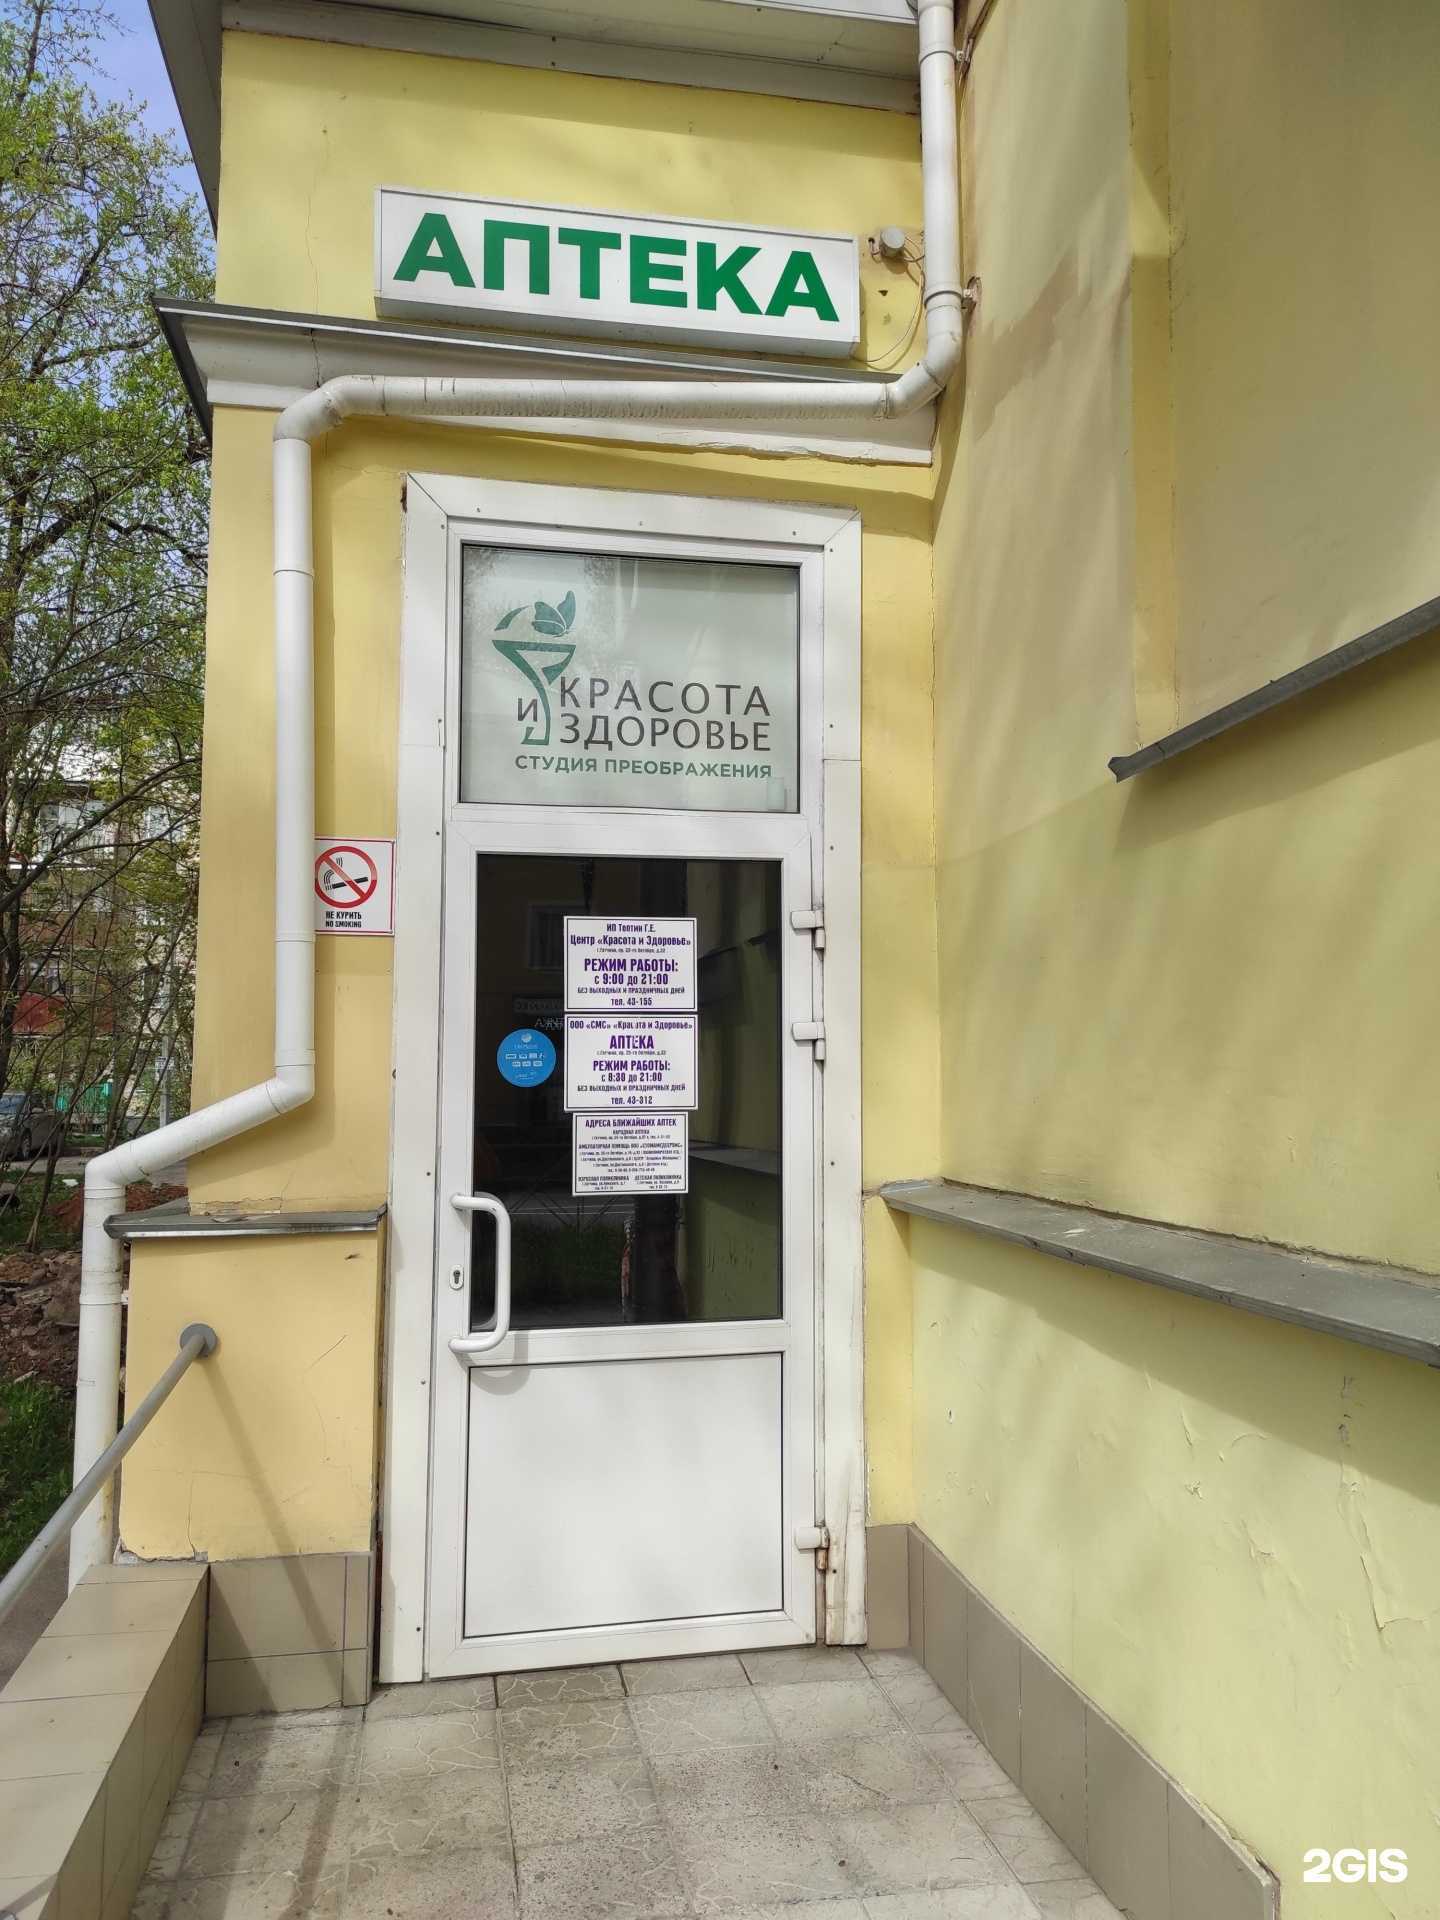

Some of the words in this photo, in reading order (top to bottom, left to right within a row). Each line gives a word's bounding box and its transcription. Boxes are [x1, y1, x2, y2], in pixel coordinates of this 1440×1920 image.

[393, 212, 840, 322] АПТЕКА
[560, 676, 770, 716] КРАСОТА
[560, 713, 771, 751] ЗДОРОВЬЕ
[515, 755, 597, 773] СТУДИЯ
[605, 759, 772, 778] ПРЕОБРАЖЕНИЯ
[325, 911, 334, 919] НЕ
[336, 911, 362, 920] КУРИТЬ
[607, 923, 616, 932] ИП
[570, 934, 595, 946] Центр
[598, 934, 636, 946] «Красота
[646, 935, 690, 946] Здоровье»
[584, 958, 626, 972] РЕЖИМ
[630, 958, 679, 972] РАБОТЫ:
[594, 976, 599, 984] с
[603, 973, 624, 984] 9:00
[627, 976, 638, 986] до
[641, 973, 669, 985] 21:00
[611, 998, 625, 1006] тел.
[627, 997, 653, 1006] 43-155
[570, 1020, 584, 1029] ООО
[586, 1020, 611, 1030] «СМС»
[654, 1020, 693, 1030] Здоровье»
[610, 1035, 654, 1049] АПТЕКА
[593, 1060, 628, 1071] РЕЖИМ
[630, 1060, 671, 1071] РАБОТЫ:
[601, 1074, 606, 1082] с
[628, 1074, 638, 1083] до
[640, 1072, 662, 1082] 21:00
[628, 1084, 669, 1092] ПРАЗДНИЧНЫХ
[670, 1083, 686, 1092] ДНЕЙ
[611, 1096, 625, 1105] тел.
[627, 1096, 653, 1105] 43-312
[585, 1120, 611, 1128] АДРЕСА
[612, 1117, 656, 1127] БЛИЖАЙШИХ
